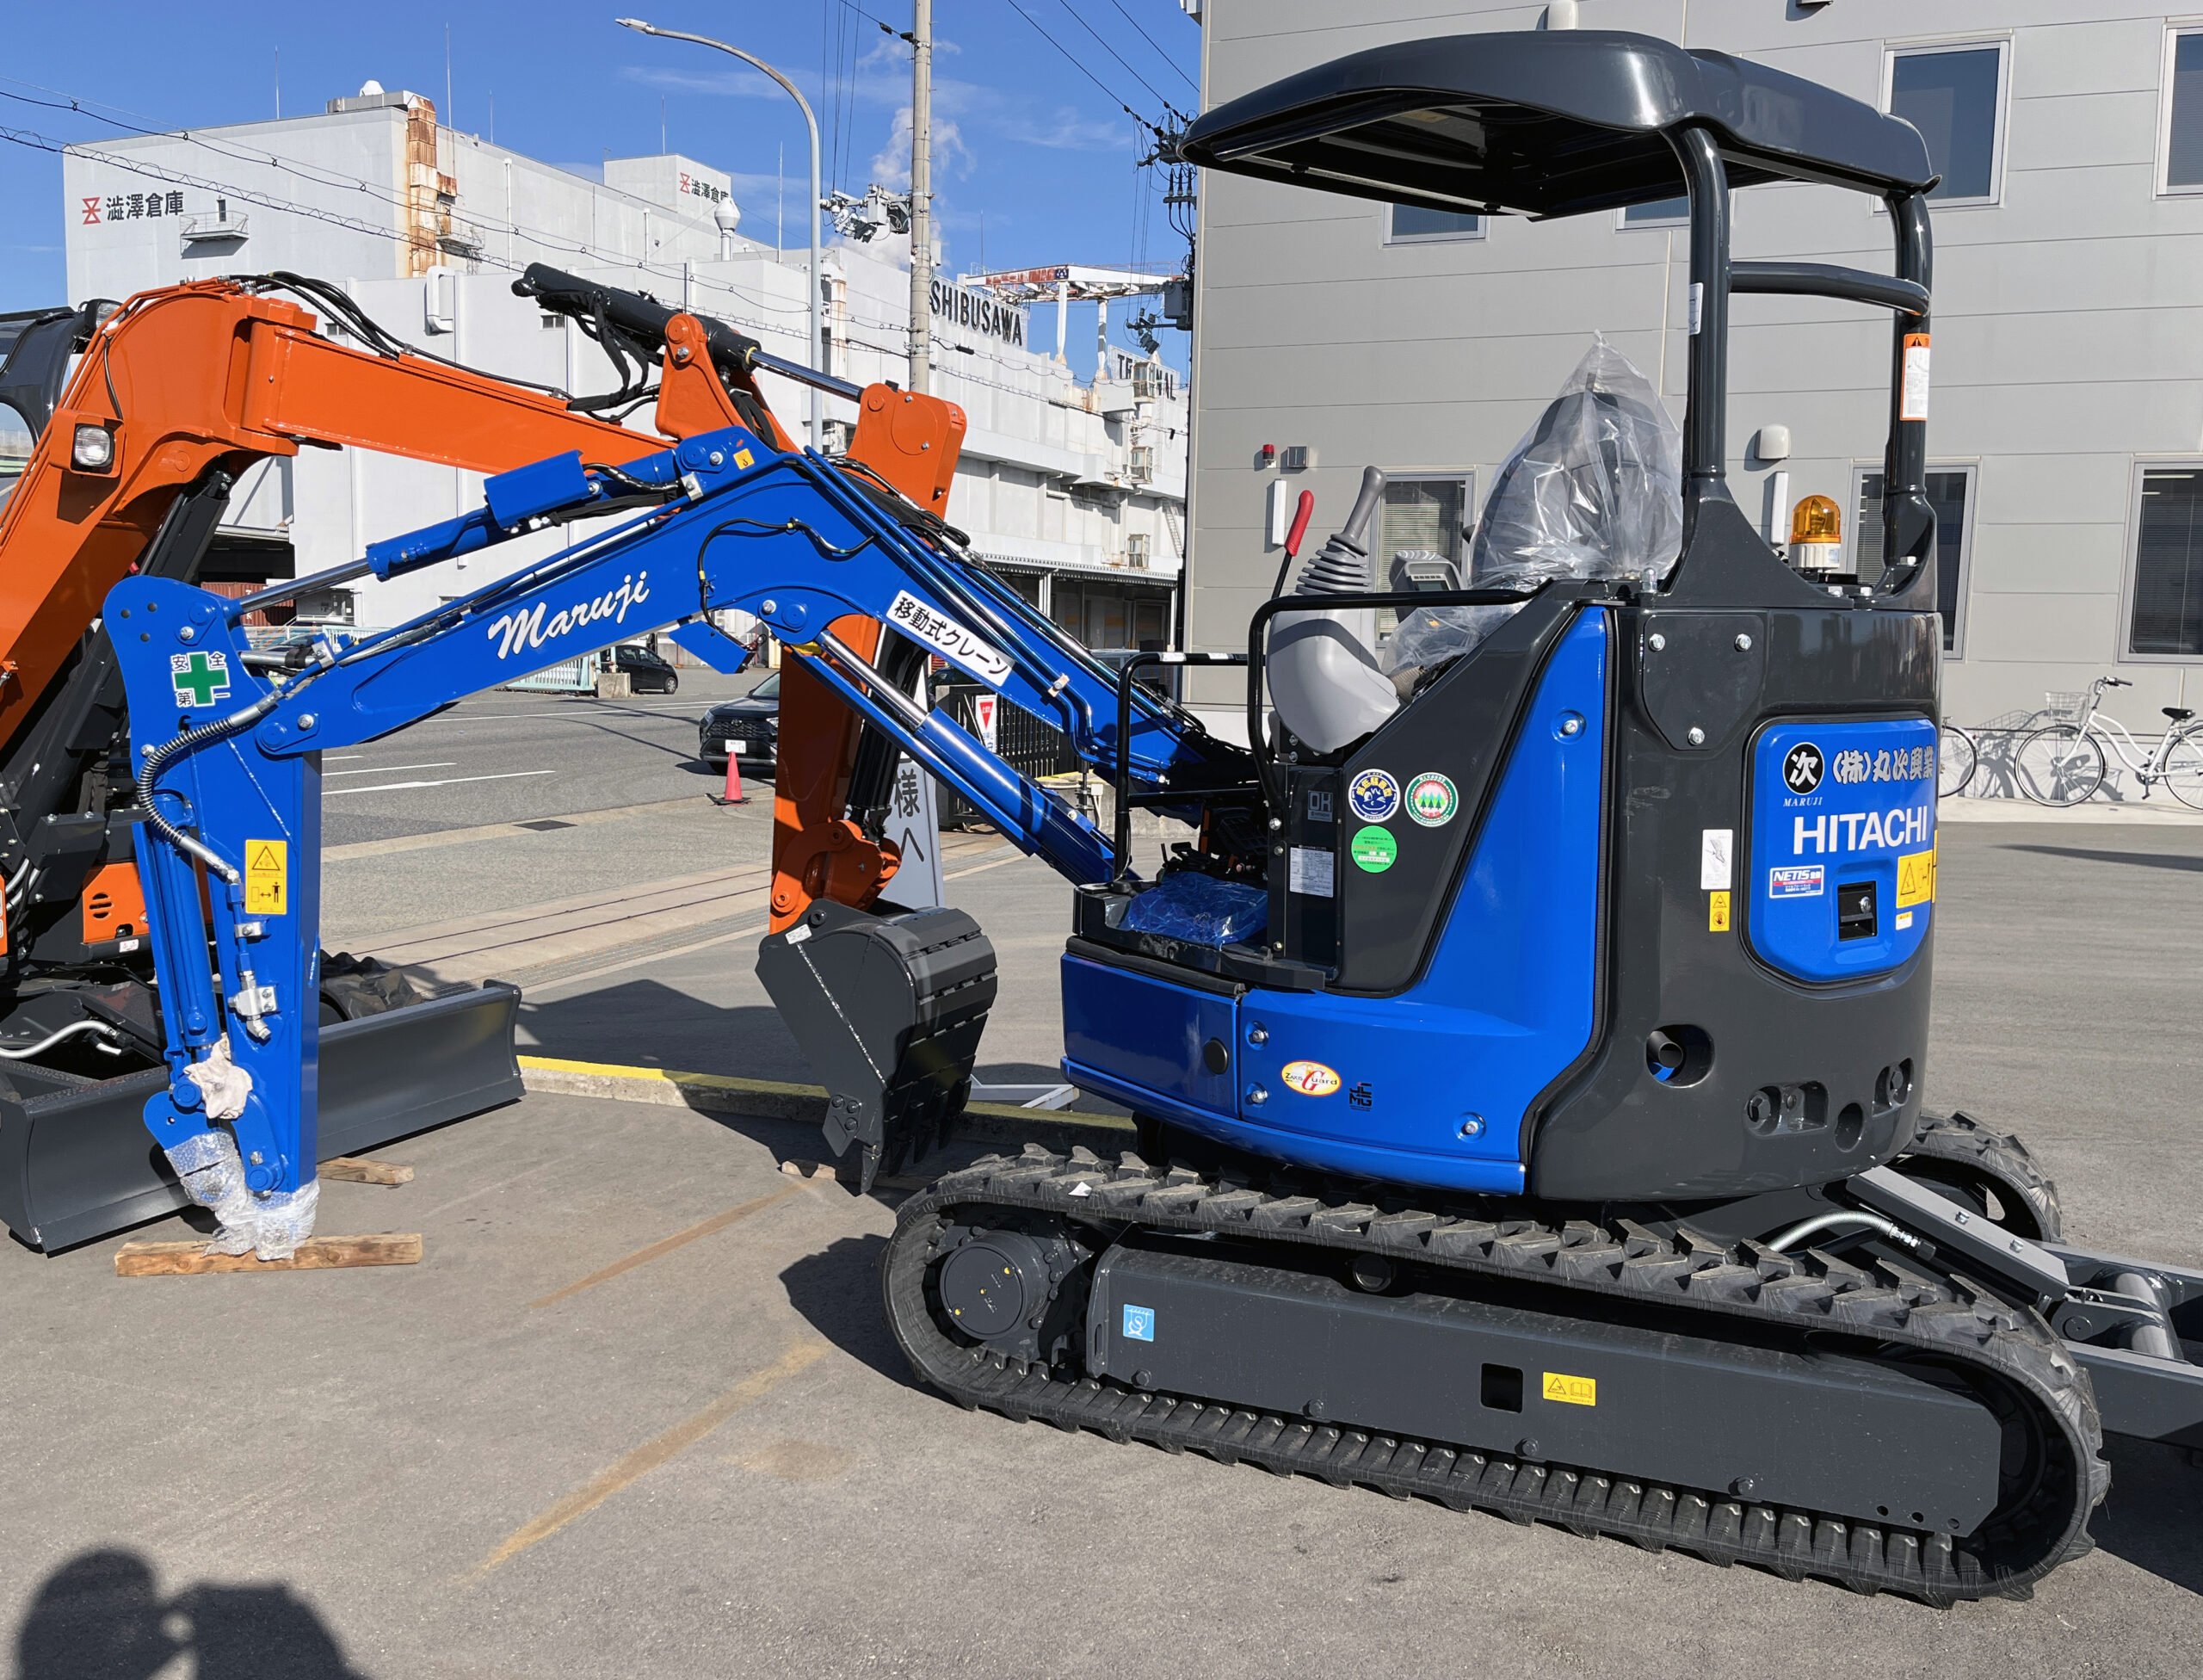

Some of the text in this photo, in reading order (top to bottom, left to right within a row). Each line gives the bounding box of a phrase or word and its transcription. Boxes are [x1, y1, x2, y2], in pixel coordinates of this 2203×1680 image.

[930, 280, 1022, 346] SHIBUSAWA
[487, 570, 651, 660] Maruji
[894, 596, 1009, 675] 移動式クレーン
[1309, 791, 1332, 812] OK
[1782, 796, 1823, 807] MARUJI
[1793, 805, 1928, 855] HITACHI
